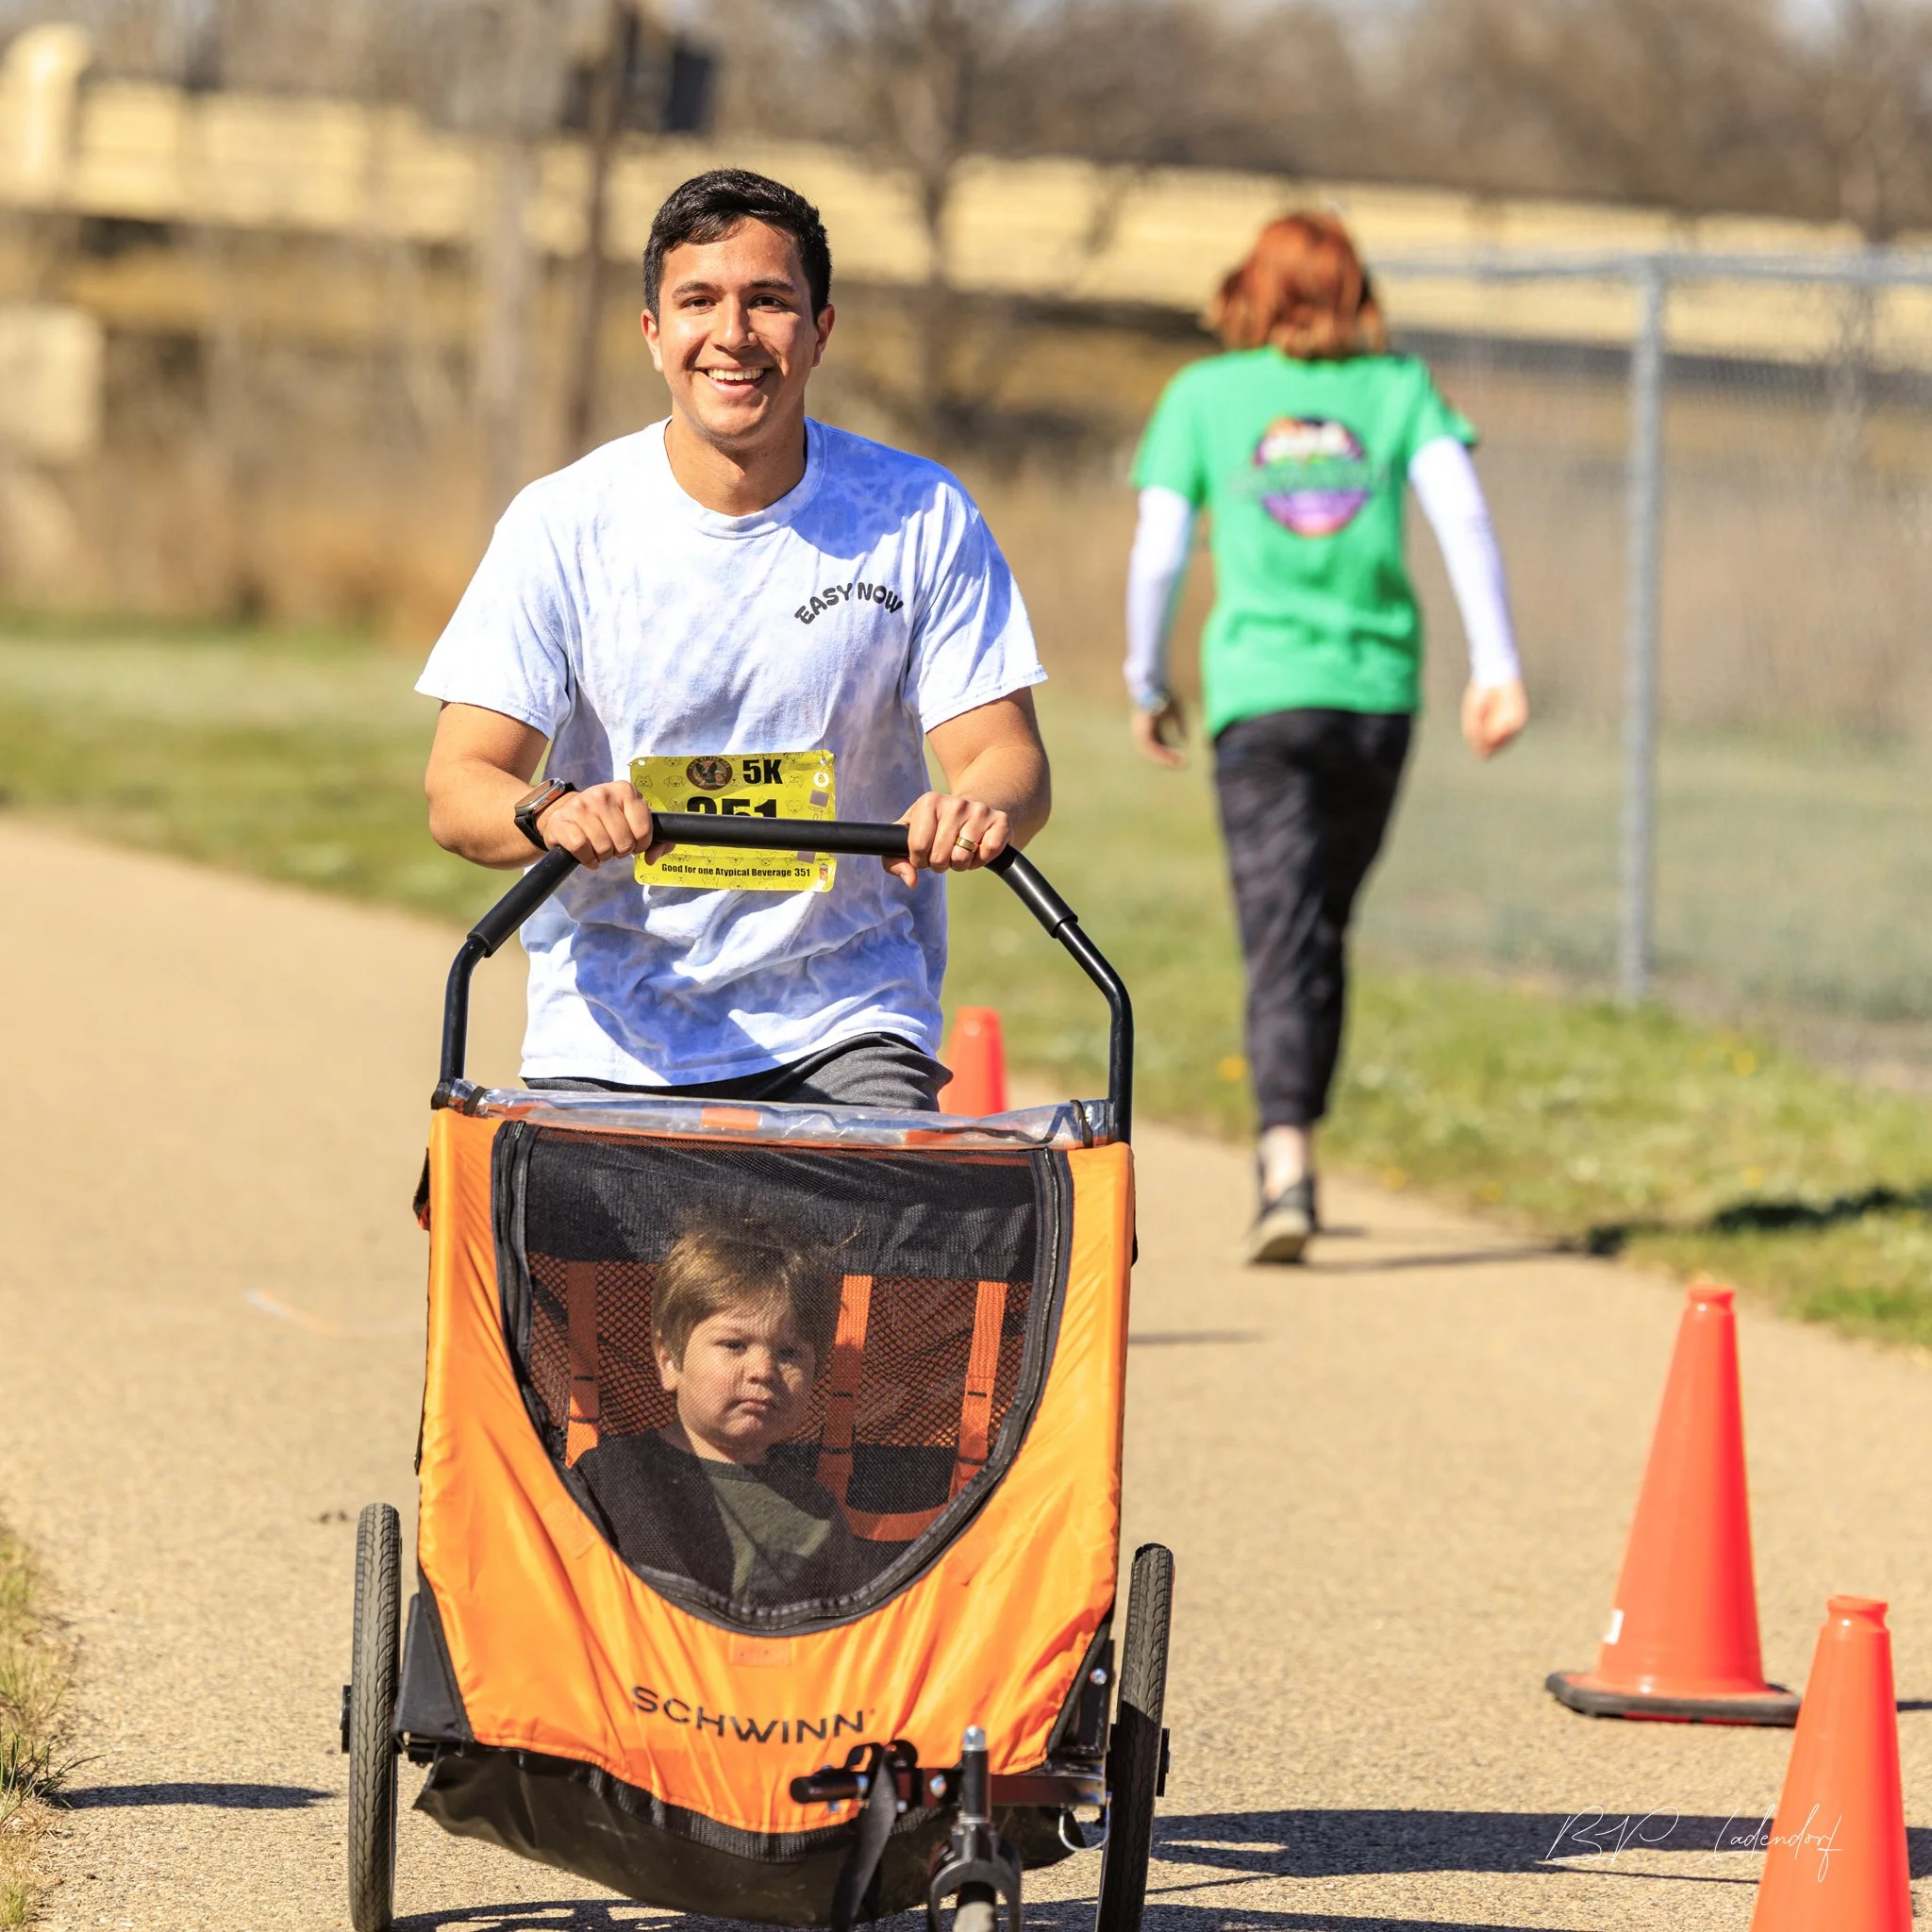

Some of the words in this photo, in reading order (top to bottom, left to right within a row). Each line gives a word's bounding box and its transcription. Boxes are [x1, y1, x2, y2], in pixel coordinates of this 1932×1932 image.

[794, 582, 853, 625] EASY
[857, 582, 904, 613] NOW
[742, 758, 783, 785] 5K
[661, 863, 683, 873] Good
[685, 865, 696, 874] for
[715, 867, 750, 877] Atypical
[752, 868, 791, 877] Beverage
[794, 868, 810, 876] 351
[632, 1686, 863, 1744] SCHWINN
